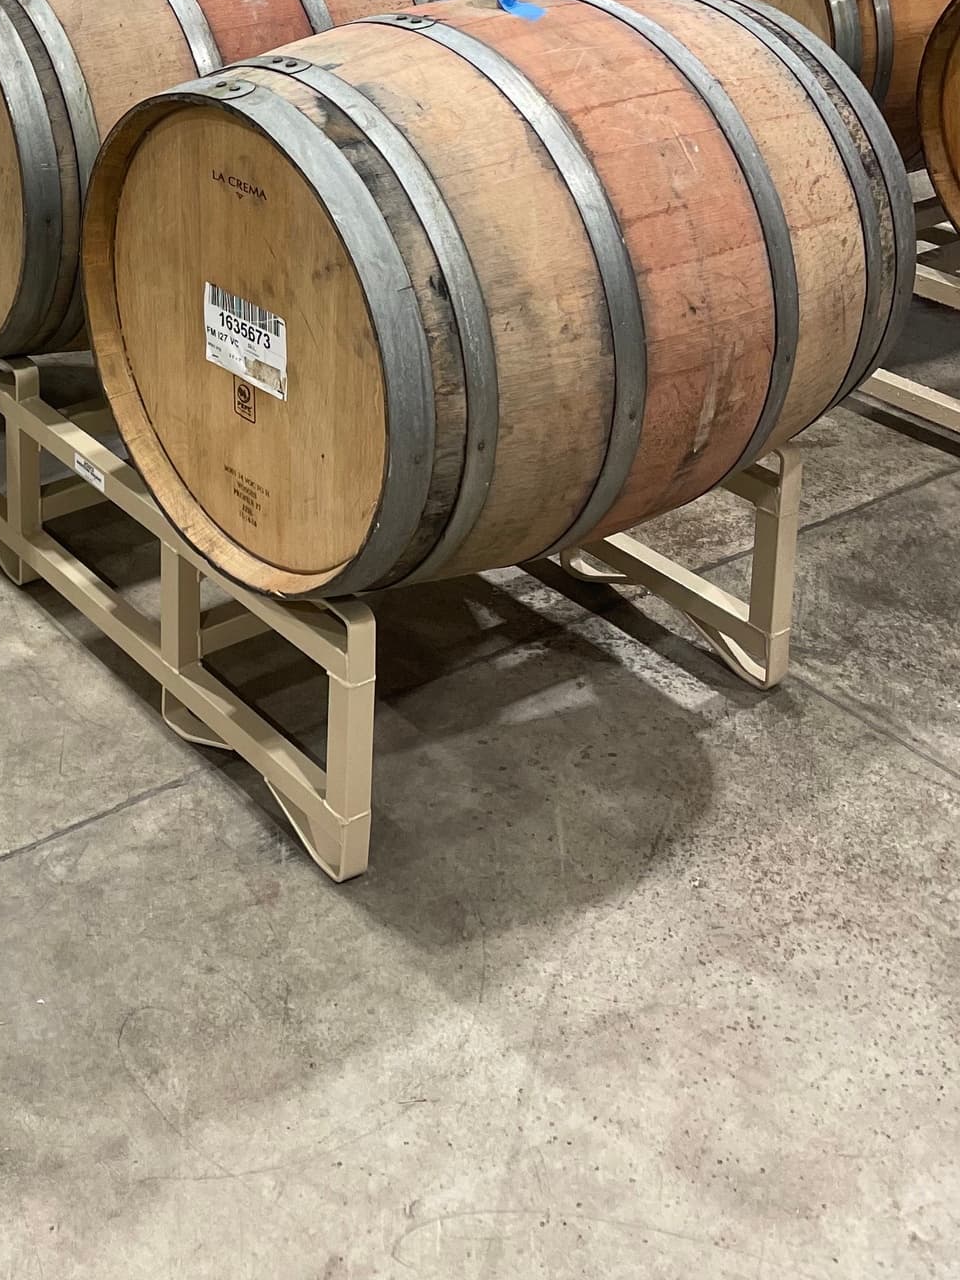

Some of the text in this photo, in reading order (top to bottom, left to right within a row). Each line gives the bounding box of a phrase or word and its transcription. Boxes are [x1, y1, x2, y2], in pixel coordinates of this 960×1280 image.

[212, 169, 267, 201] LA CREMA
[219, 311, 271, 350] 1635673
